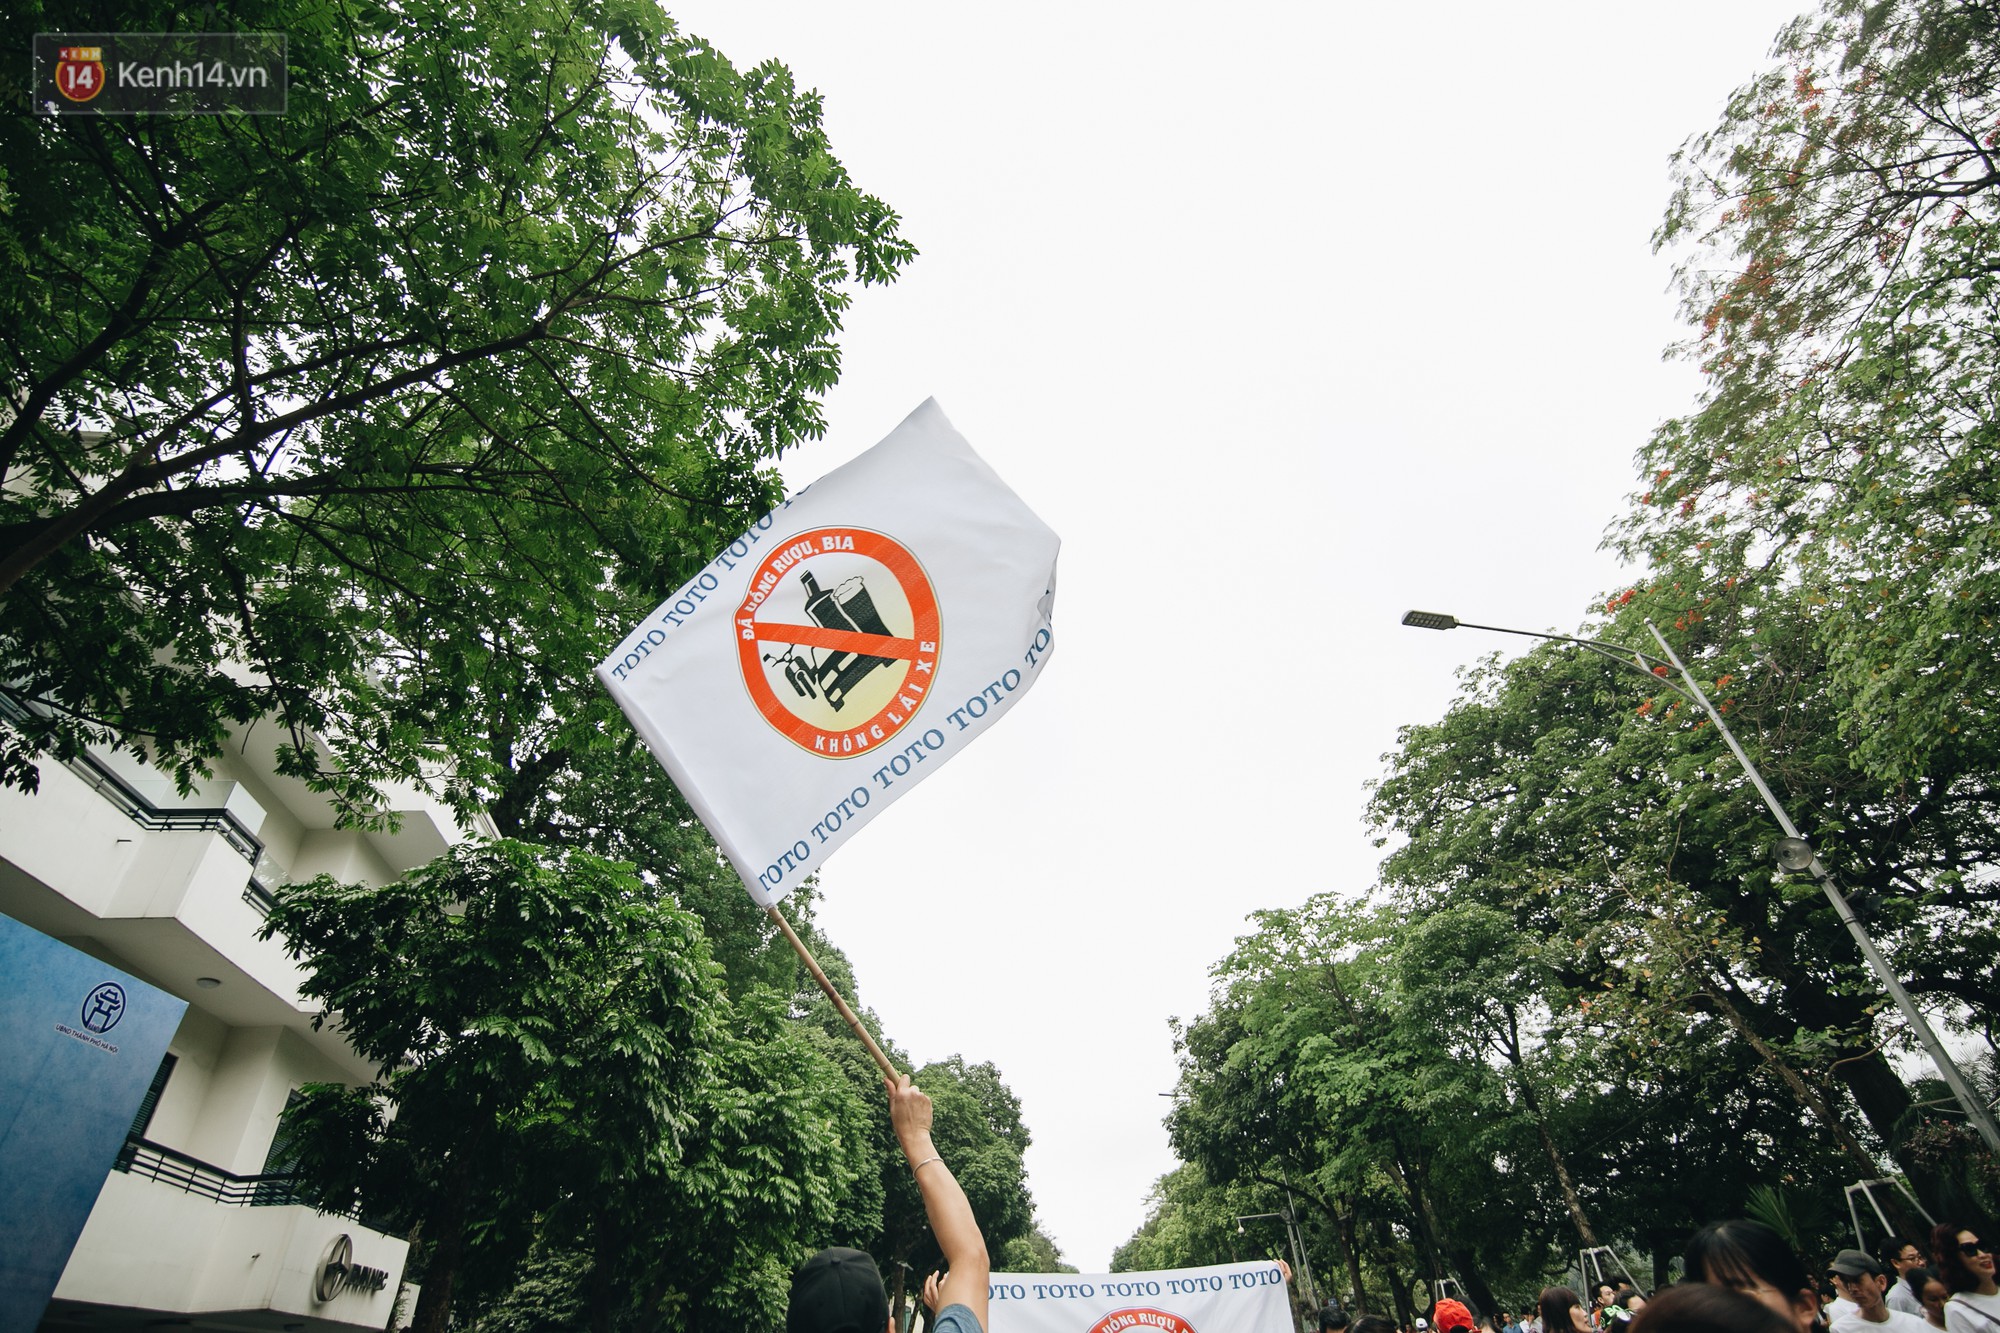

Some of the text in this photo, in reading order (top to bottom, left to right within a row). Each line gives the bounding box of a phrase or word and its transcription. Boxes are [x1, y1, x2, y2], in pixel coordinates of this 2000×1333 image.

[822, 536, 854, 551] BIA
[611, 511, 773, 681] TOTO TOTO TOTO
[744, 571, 778, 612] UỐNG
[737, 618, 755, 640] ĐÃ
[815, 641, 936, 753] KHÔNG LÁI XE
[758, 616, 1052, 892] TOTO TOTO TOTO TOTO TO
[1033, 1283, 1095, 1299] TOTO
[1101, 1281, 1161, 1297] TOTO
[1167, 1275, 1222, 1294] TOTO
[1229, 1268, 1281, 1289] TOTO
